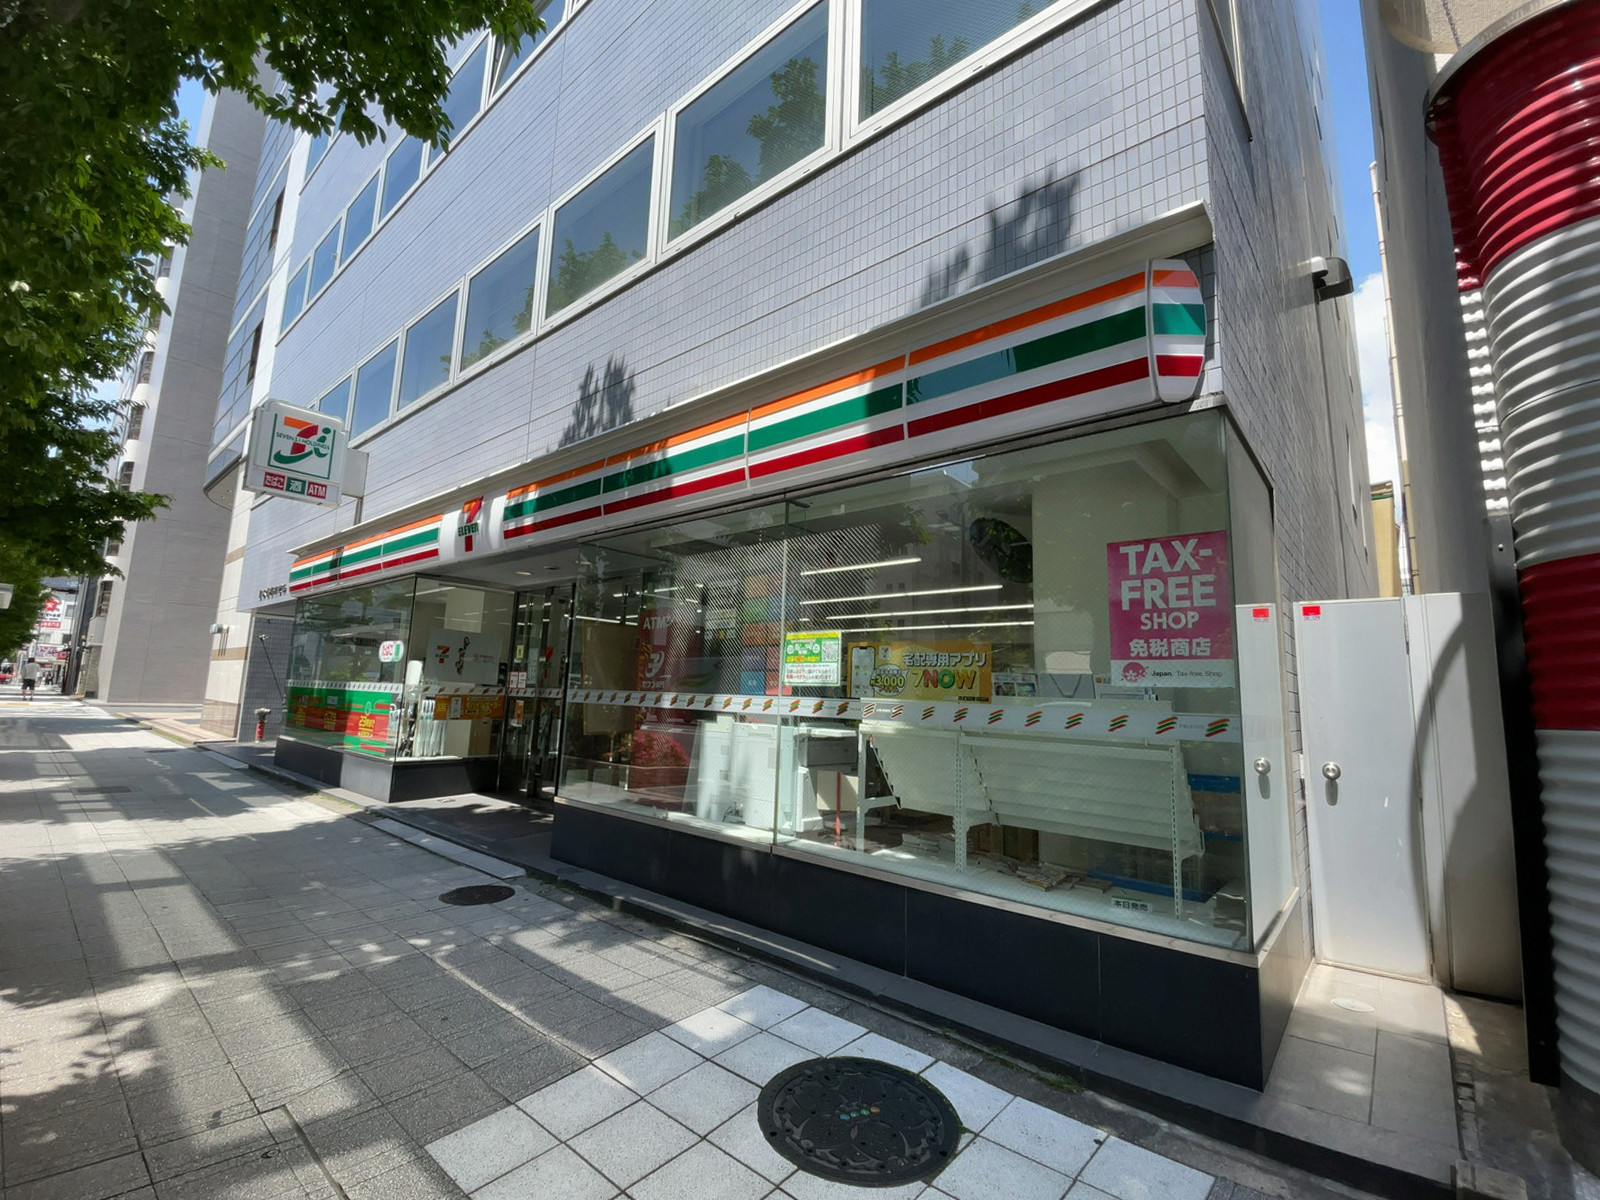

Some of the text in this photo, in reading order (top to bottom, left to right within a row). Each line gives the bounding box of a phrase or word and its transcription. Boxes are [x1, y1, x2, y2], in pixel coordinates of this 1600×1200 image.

[275, 431, 296, 442] SEVEN
[289, 480, 304, 492] 酒
[307, 484, 327, 498] ATM
[458, 523, 479, 537] ELEVEN
[1119, 538, 1213, 576] TAX-
[1121, 574, 1217, 611] FREE
[1140, 610, 1200, 631] SHOP
[1129, 637, 1212, 658] 免税商店
[902, 652, 987, 667] 宅配専用アプリ
[911, 669, 977, 690] 7NOW
